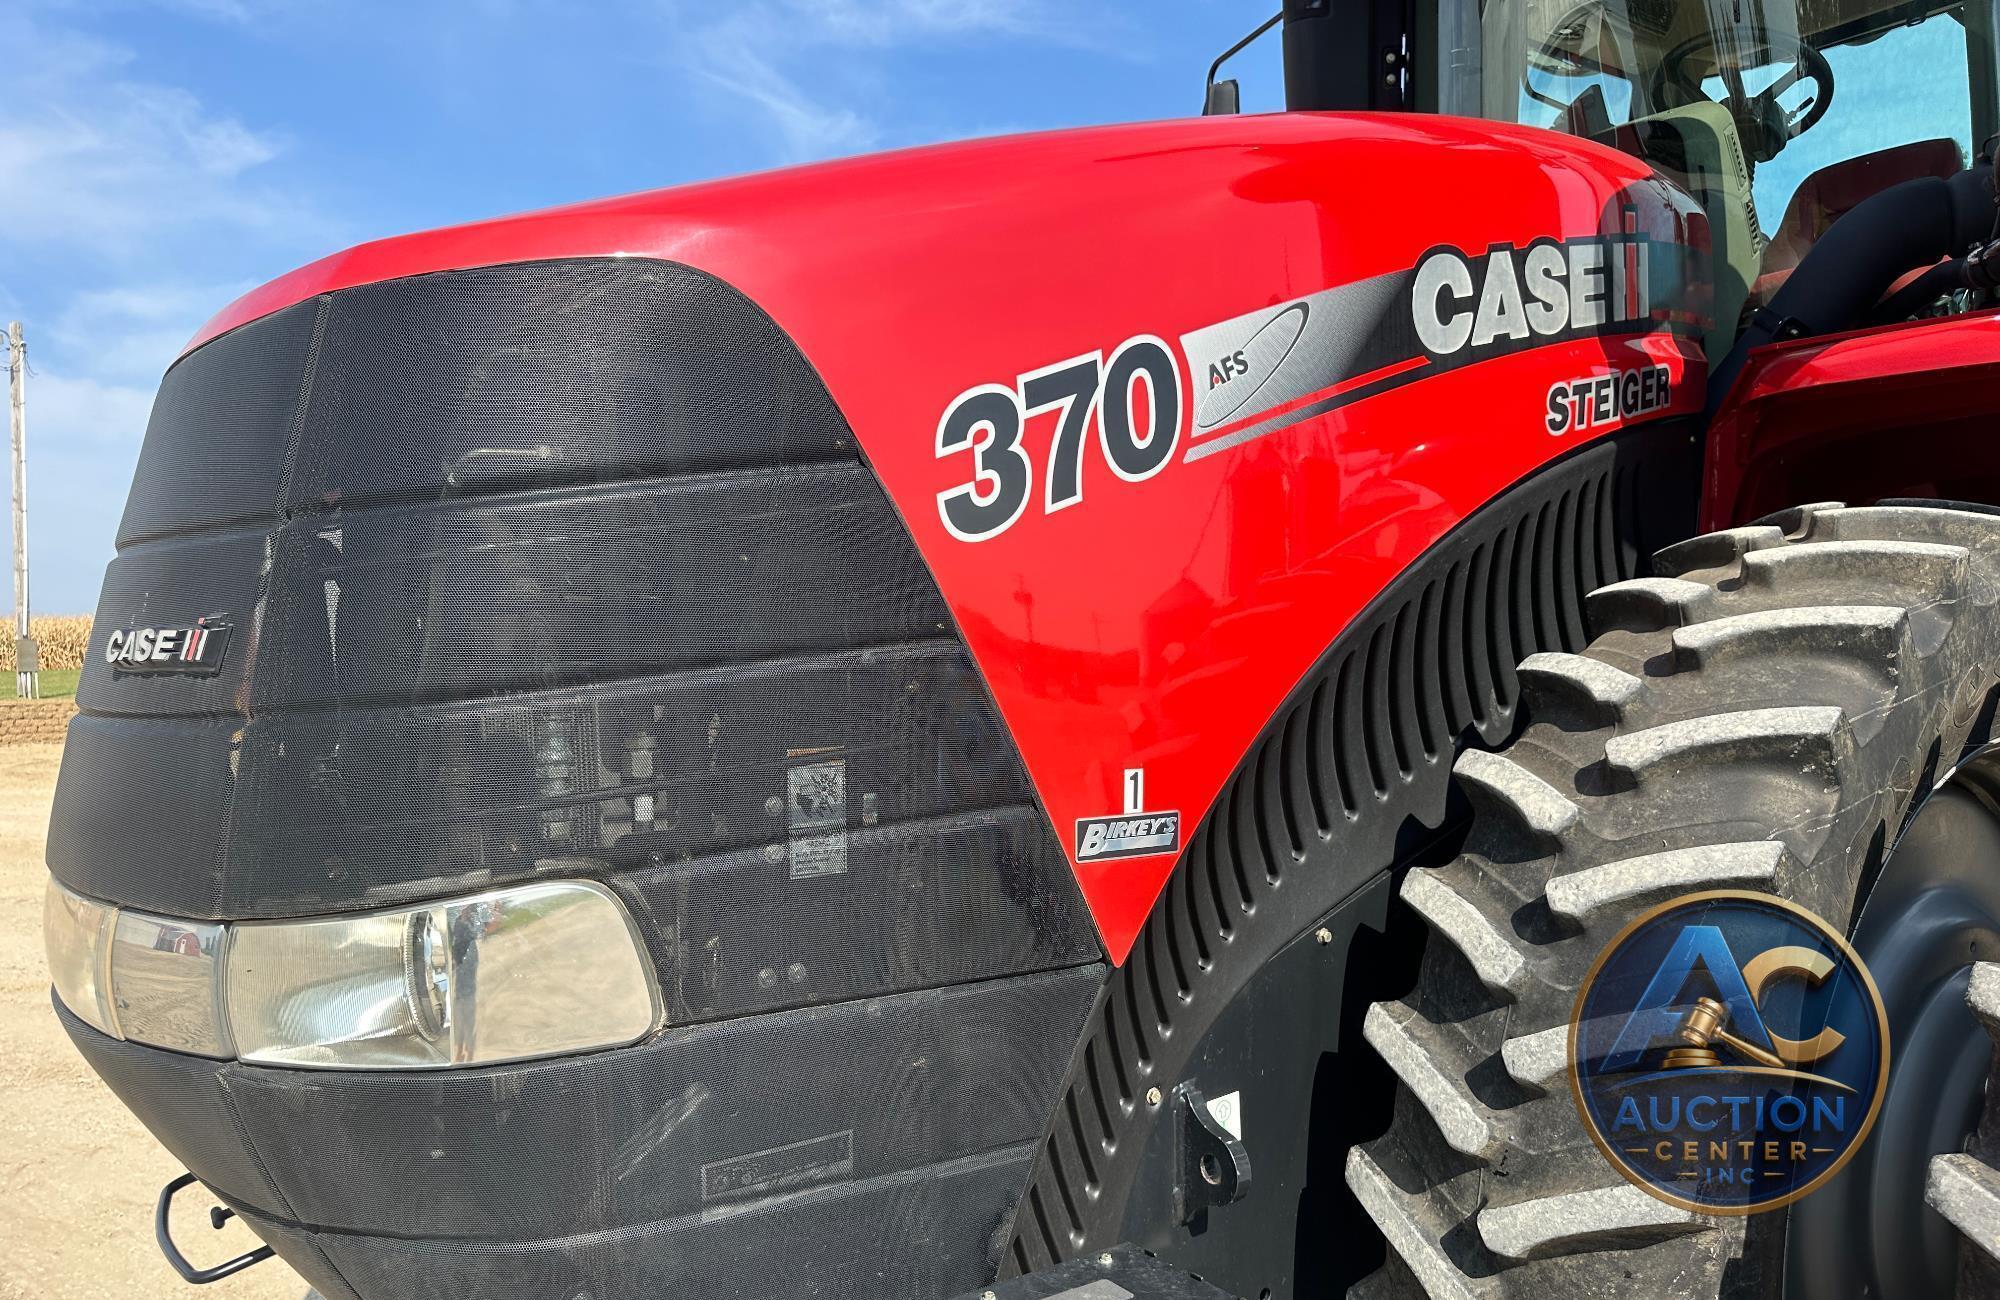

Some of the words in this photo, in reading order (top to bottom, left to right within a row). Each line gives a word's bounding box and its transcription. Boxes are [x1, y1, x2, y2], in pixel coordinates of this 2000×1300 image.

[1411, 244, 1606, 354] CASE
[1208, 349, 1249, 391] AFS
[1545, 363, 1671, 436] STEIGER
[935, 334, 1182, 543] 370
[105, 628, 177, 663] CASE
[1129, 771, 1139, 810] 1
[1079, 816, 1177, 857] BIRKEY'S
